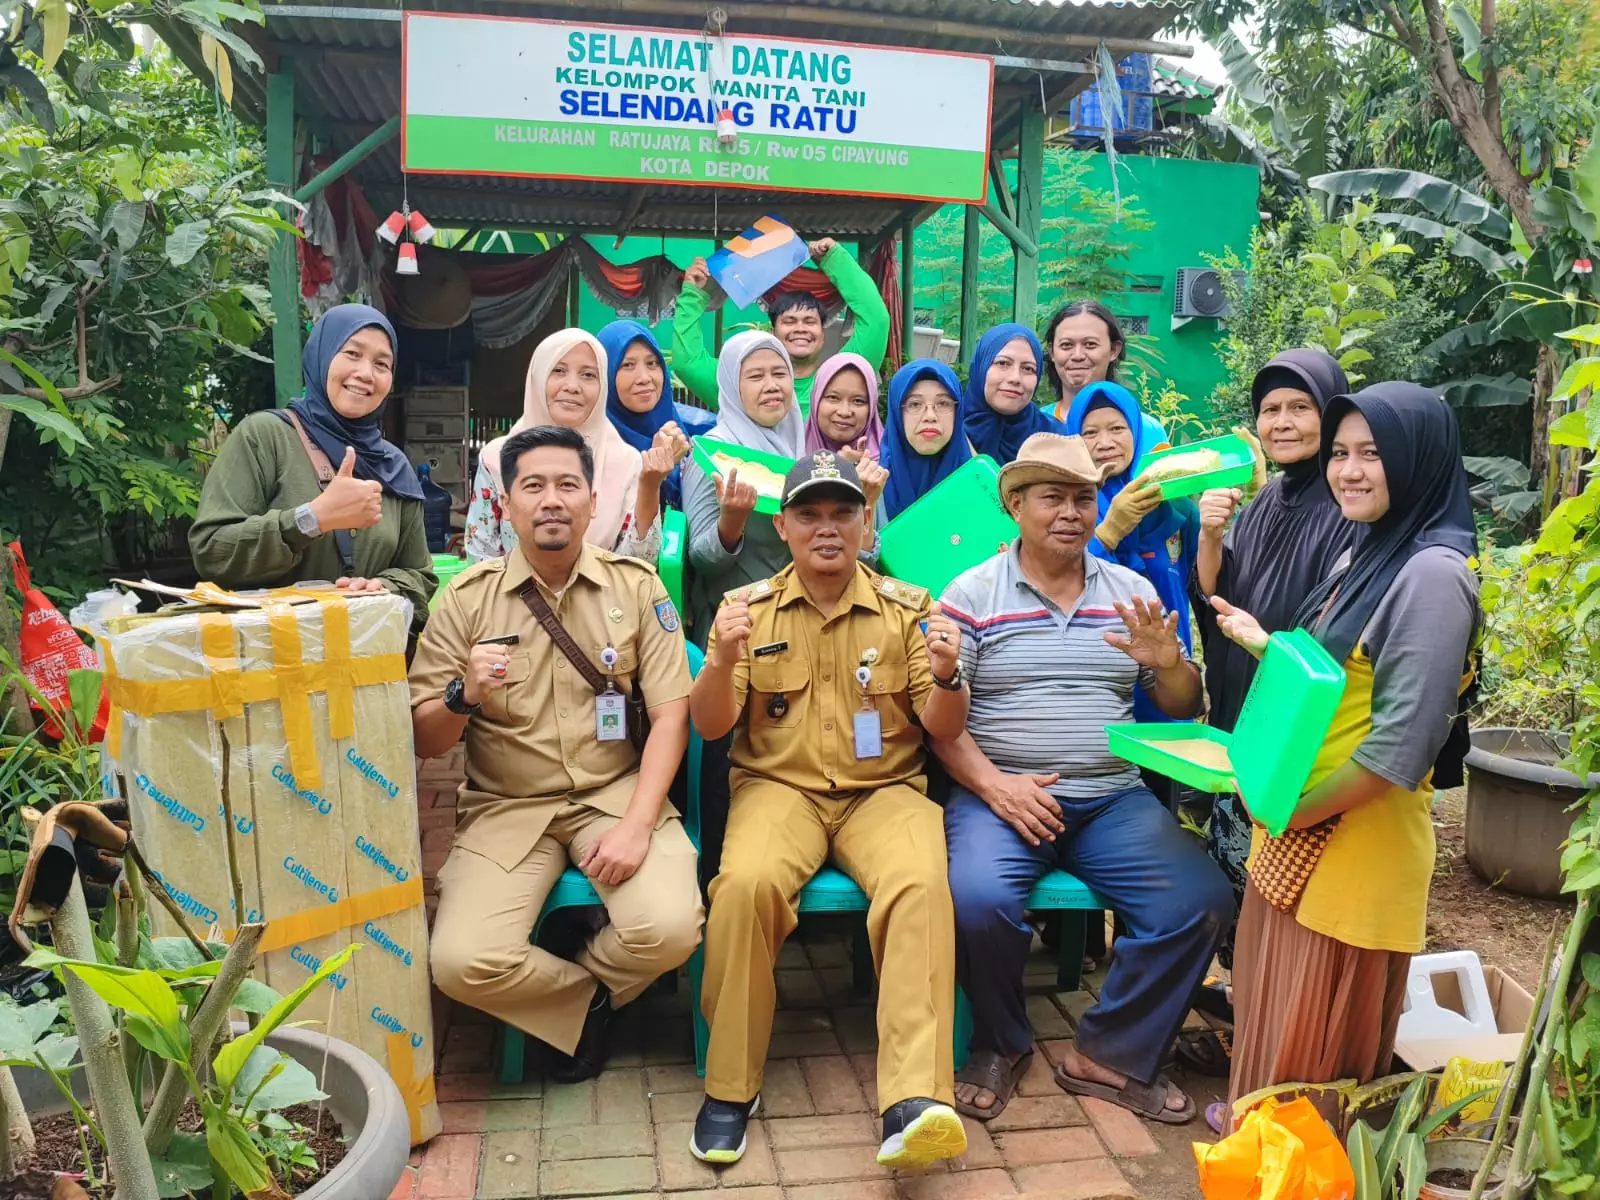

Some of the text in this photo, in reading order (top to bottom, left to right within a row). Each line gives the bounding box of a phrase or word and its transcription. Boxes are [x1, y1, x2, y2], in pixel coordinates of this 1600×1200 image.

[567, 31, 852, 85] SELAMAT DATANG
[555, 67, 866, 107] KELOMPOK WANITA TANI
[559, 89, 857, 134] SELENDANG RATU
[495, 124, 596, 147] KELURAHAN
[609, 130, 692, 152] RATUJAYA
[767, 140, 800, 158] Rw
[802, 144, 827, 162] 05
[831, 145, 909, 167] CIPAYUNG
[640, 156, 770, 182] KOTA DEPOK
[346, 748, 389, 789] Cultilene
[147, 786, 206, 832] Cultilene
[355, 835, 397, 875] Cultilene
[283, 856, 329, 895] Cultilene
[290, 945, 337, 984] Cultile
